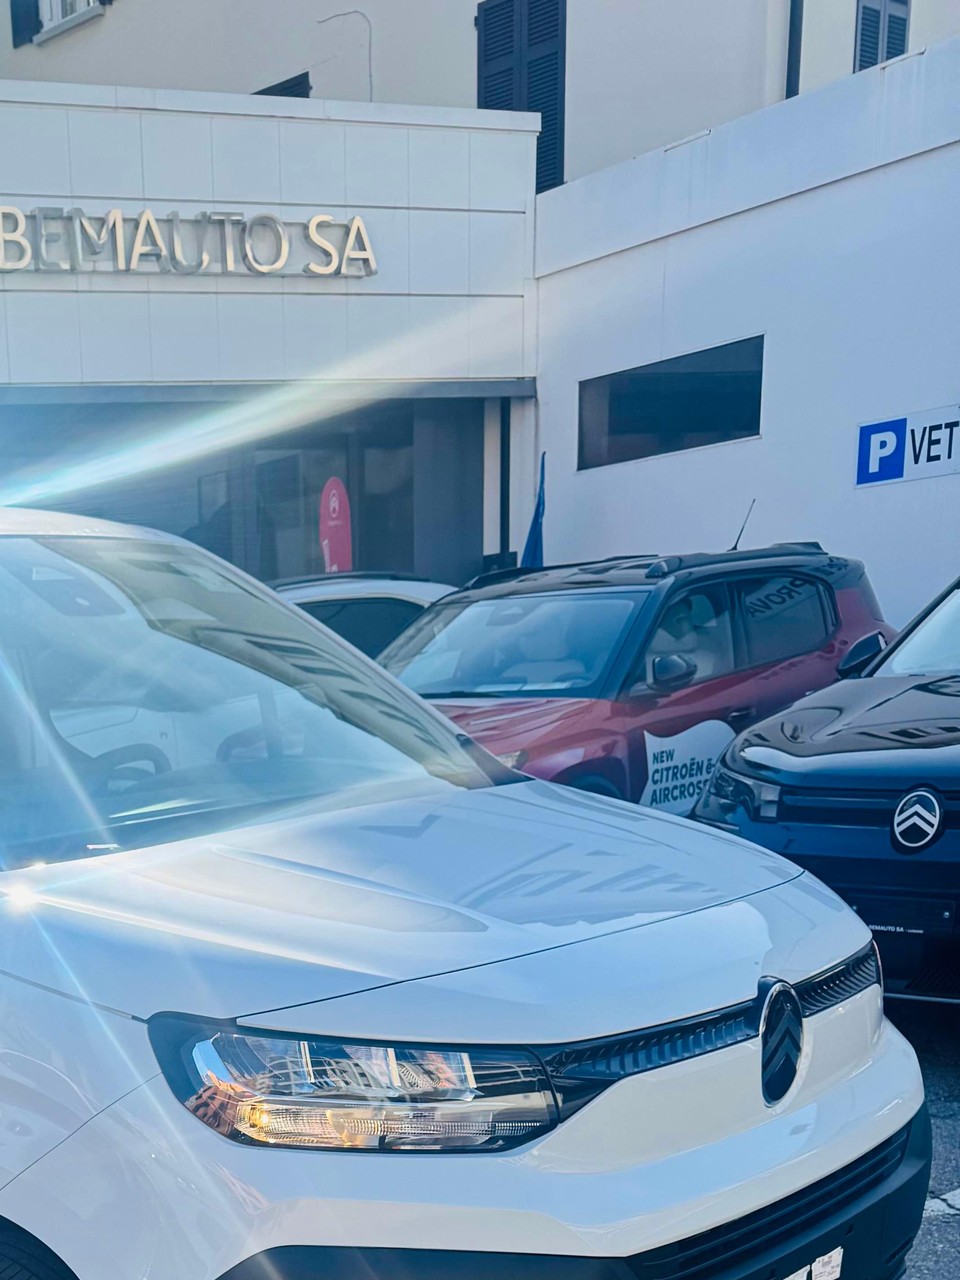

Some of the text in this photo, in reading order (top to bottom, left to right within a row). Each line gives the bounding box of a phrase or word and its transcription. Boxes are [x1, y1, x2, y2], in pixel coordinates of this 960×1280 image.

[304, 213, 377, 277] SA
[869, 420, 960, 473] P VET
[651, 757, 704, 785] CITROËN
[652, 748, 675, 765] NEW
